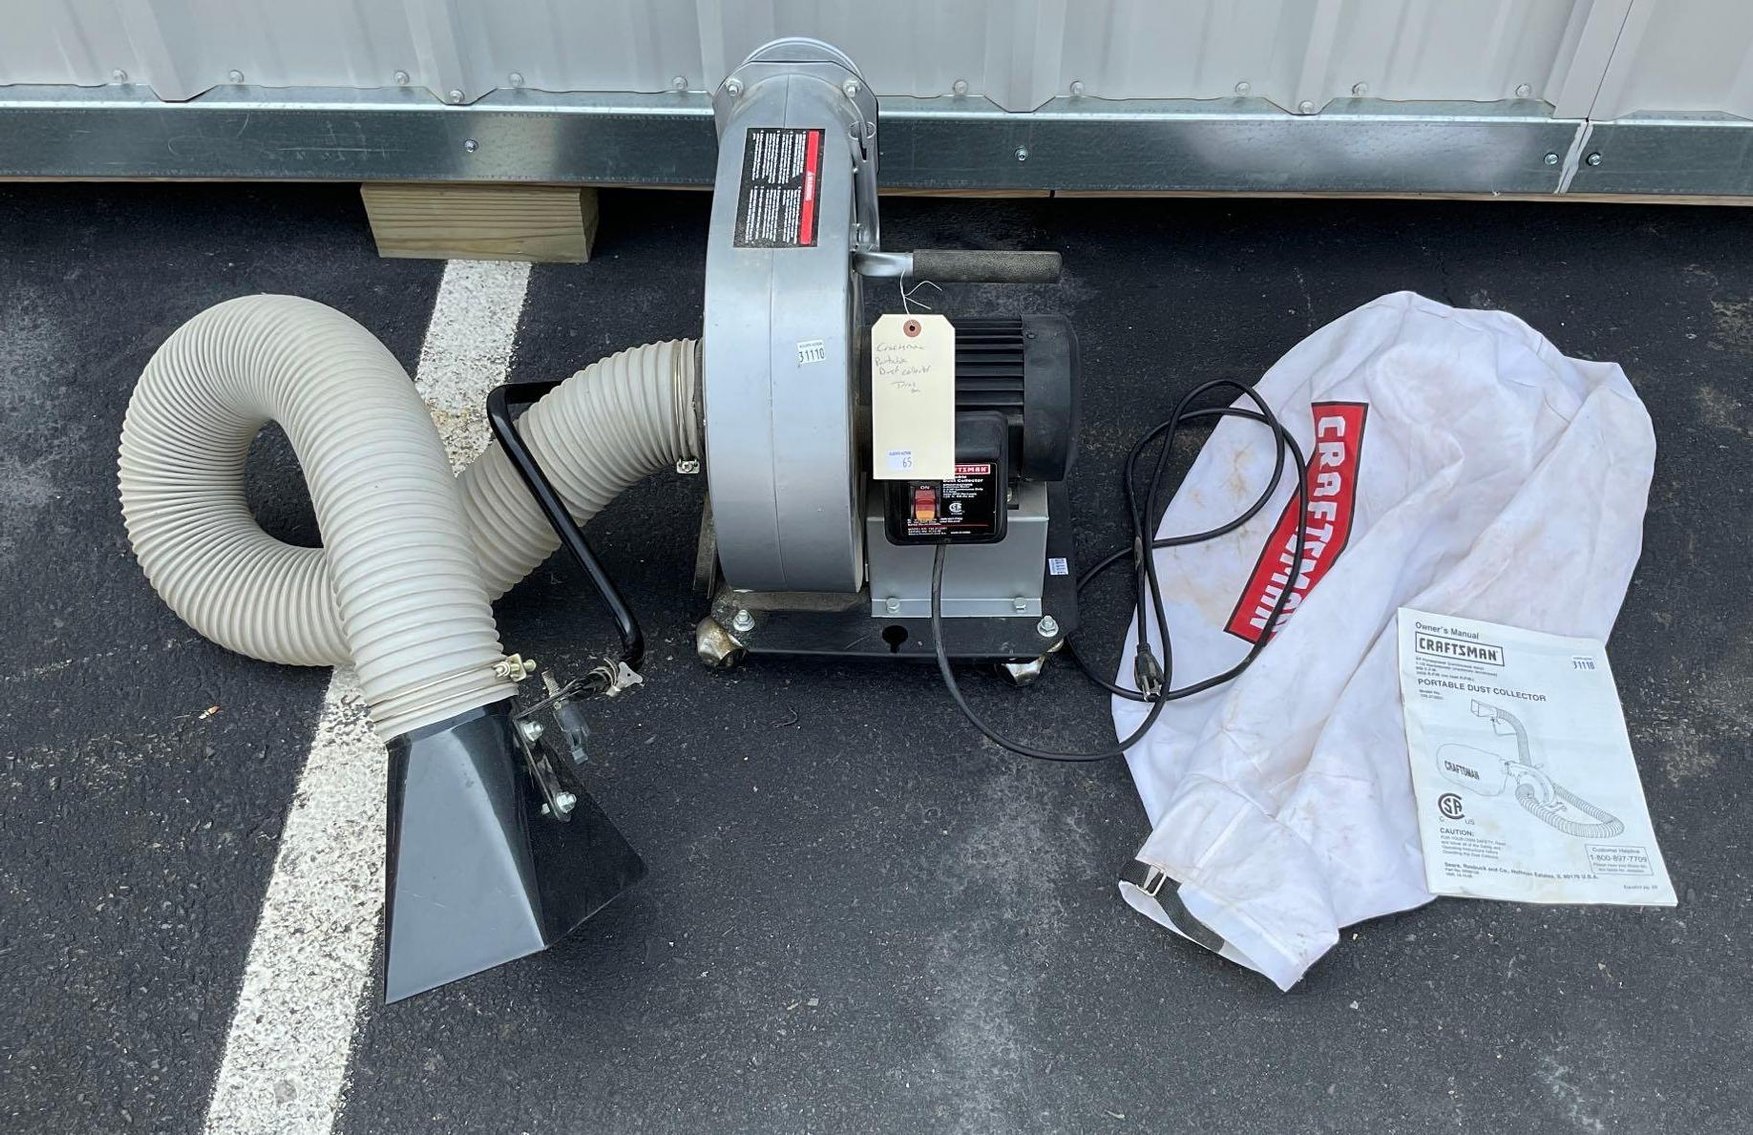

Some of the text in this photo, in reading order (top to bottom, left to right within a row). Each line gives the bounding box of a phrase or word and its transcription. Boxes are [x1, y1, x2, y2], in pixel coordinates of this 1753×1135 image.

[799, 348, 825, 363] 31110
[1415, 621, 1479, 640] Owner's Manual
[1419, 637, 1498, 661] CRAFTSMAN
[1418, 678, 1547, 702] PORTABLE DUST COLLECTOR
